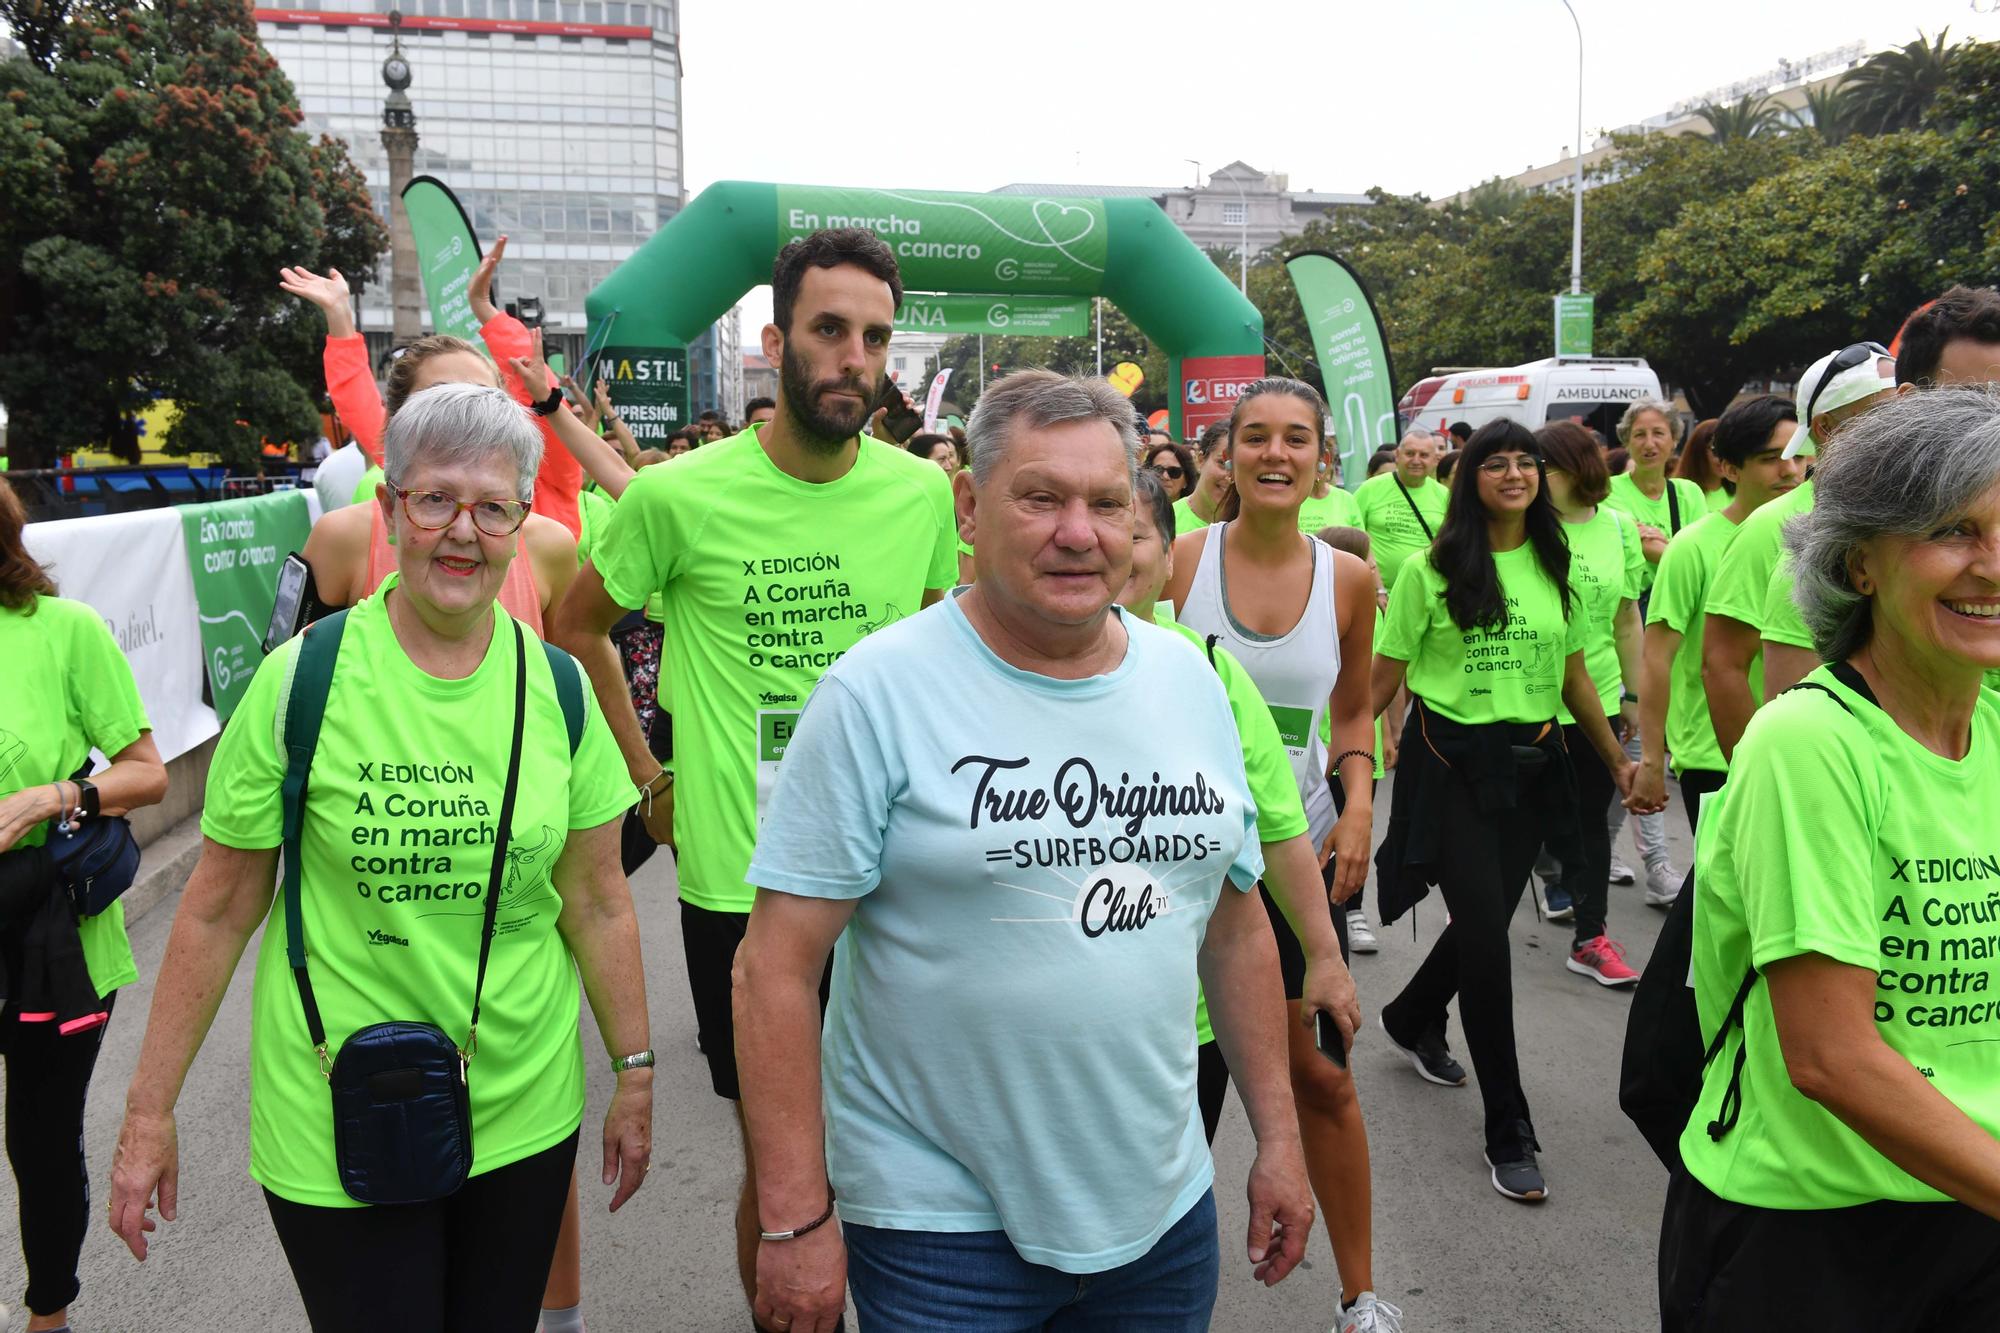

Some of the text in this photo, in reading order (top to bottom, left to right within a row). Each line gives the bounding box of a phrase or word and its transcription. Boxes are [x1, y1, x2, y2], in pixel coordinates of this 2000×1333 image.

[789, 209, 920, 235] En marcha
[898, 240, 981, 260] cancro
[894, 301, 946, 327] UÑA
[599, 359, 682, 382] MASTIL
[1213, 382, 1248, 398] ERO
[1556, 388, 1650, 400] AMBULANCIA
[613, 402, 677, 421] PRESIÓN
[626, 423, 667, 438] GITAL
[742, 552, 840, 577] X EDICIÓN
[743, 579, 851, 605] A Coruña
[745, 600, 868, 626] en marcha
[747, 629, 824, 648] contra
[1463, 628, 1538, 645] en marcha
[749, 652, 764, 667] o
[1466, 645, 1510, 659] contra
[1464, 659, 1522, 674] o cancro
[759, 691, 797, 704] Vegalsa
[1280, 733, 1299, 741] ncro
[1289, 749, 1304, 757] 1367
[358, 761, 474, 784] X EDICIÓN
[354, 791, 490, 818] A Coruña
[950, 755, 1225, 837] True Originals
[351, 820, 514, 847] en march
[1013, 833, 1209, 868] SURFBOARDS
[351, 852, 452, 875] contra
[1890, 852, 2000, 883] X EDICIÓN
[357, 881, 482, 904] o cancro
[1080, 878, 1157, 939] Club
[1882, 892, 2000, 927] A Coruñ
[1879, 935, 2000, 961] en mar
[1876, 967, 1989, 995] contra
[1874, 1000, 2000, 1028] o cancr
